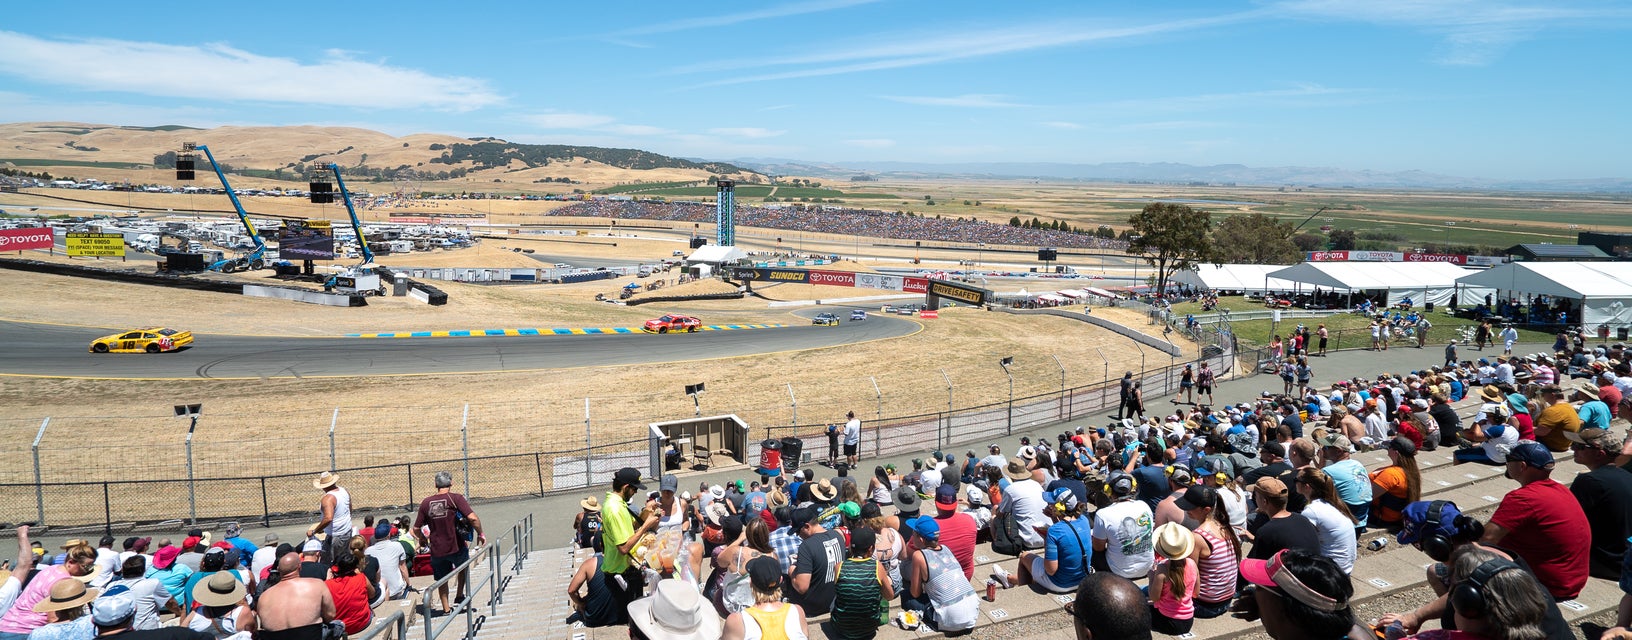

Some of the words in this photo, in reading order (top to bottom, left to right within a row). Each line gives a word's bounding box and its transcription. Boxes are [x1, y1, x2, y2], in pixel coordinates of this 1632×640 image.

[10, 234, 52, 244] TOYOTA
[1424, 255, 1460, 263] TOYOTA
[769, 271, 806, 280] SUNOCO
[822, 274, 854, 283] TOYOTA
[903, 280, 927, 292] Lucky
[933, 283, 952, 295] DRIVE
[954, 287, 980, 301] SAFETY
[122, 341, 135, 349] 18
